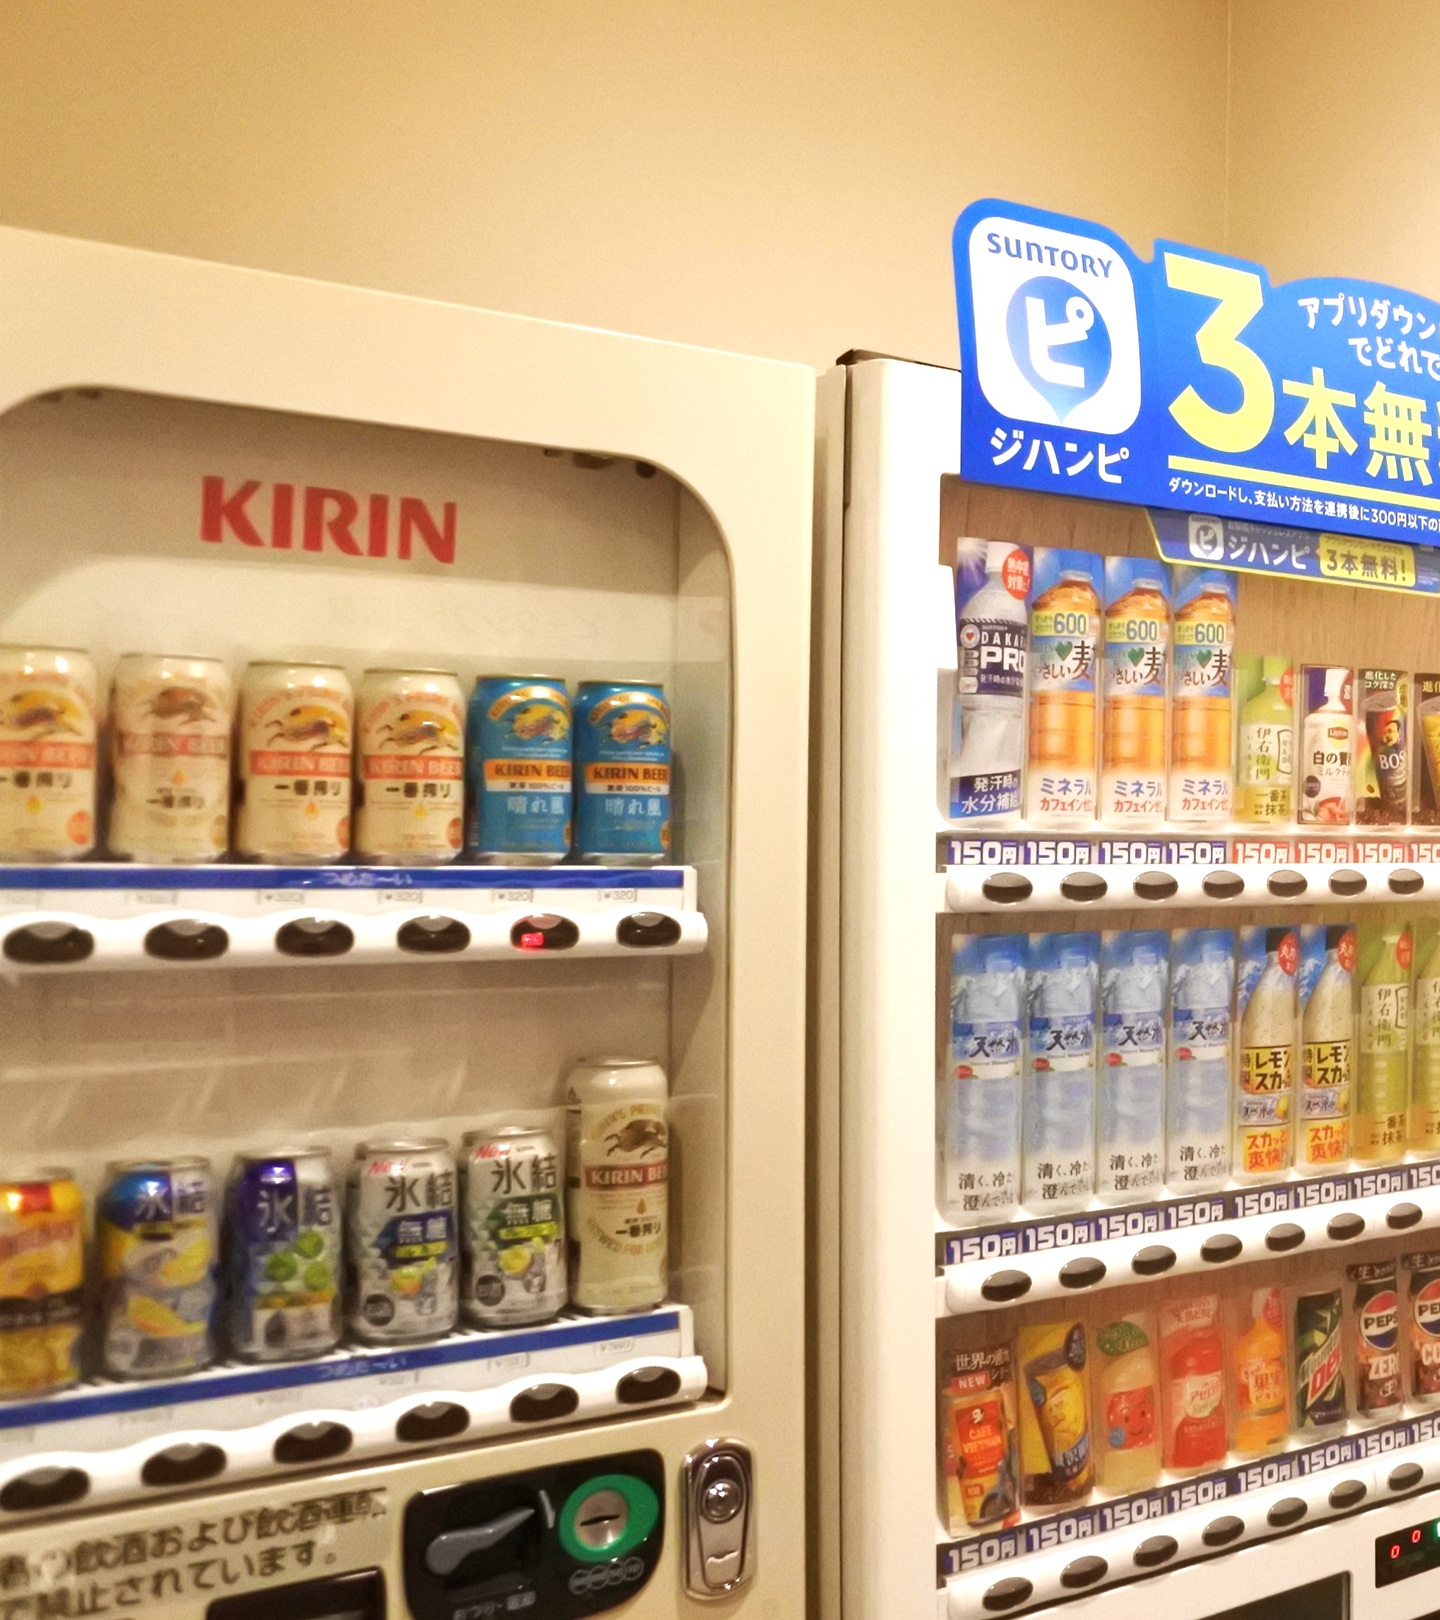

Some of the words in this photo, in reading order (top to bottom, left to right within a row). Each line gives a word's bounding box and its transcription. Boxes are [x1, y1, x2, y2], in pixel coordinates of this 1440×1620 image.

[986, 232, 1112, 278] SUNTORY
[1025, 296, 1095, 389] ピ
[990, 427, 1130, 484] ジハンピ
[201, 475, 458, 564] KIRIN
[1227, 535, 1311, 570] ジハンピ
[1326, 548, 1407, 582] 3本無料!
[1053, 612, 1087, 635] 600
[1126, 619, 1158, 641] 600
[1194, 623, 1225, 644] 600
[494, 763, 543, 778] KIRIN
[593, 767, 639, 781] KIRIN
[951, 840, 1018, 865] 150円
[1026, 841, 1091, 865] 150円
[1101, 841, 1162, 865] 150円
[1168, 842, 1225, 865] 150円
[1235, 843, 1289, 864] 150円
[1298, 843, 1350, 863] 150円
[1356, 843, 1405, 863] 150円
[490, 1154, 557, 1195] 氷結
[591, 1167, 643, 1185] KIRIN
[1353, 1174, 1401, 1198] 150円
[384, 1171, 453, 1212] 氷結
[1295, 1184, 1347, 1208] 150円
[1167, 1200, 1224, 1230] 150円
[1235, 1193, 1287, 1217] 150円
[1026, 1223, 1092, 1251] 150円
[1098, 1212, 1159, 1241] 150円
[950, 1235, 1017, 1263] 150円
[958, 1374, 987, 1390] NEW
[1358, 1431, 1406, 1457] 150円
[1301, 1448, 1351, 1475] 150円
[1238, 1463, 1292, 1492] 150円
[1171, 1480, 1227, 1509] 150円
[1102, 1498, 1162, 1526] 150円
[1029, 1518, 1092, 1546] 150円
[949, 1542, 1017, 1572] 150円
